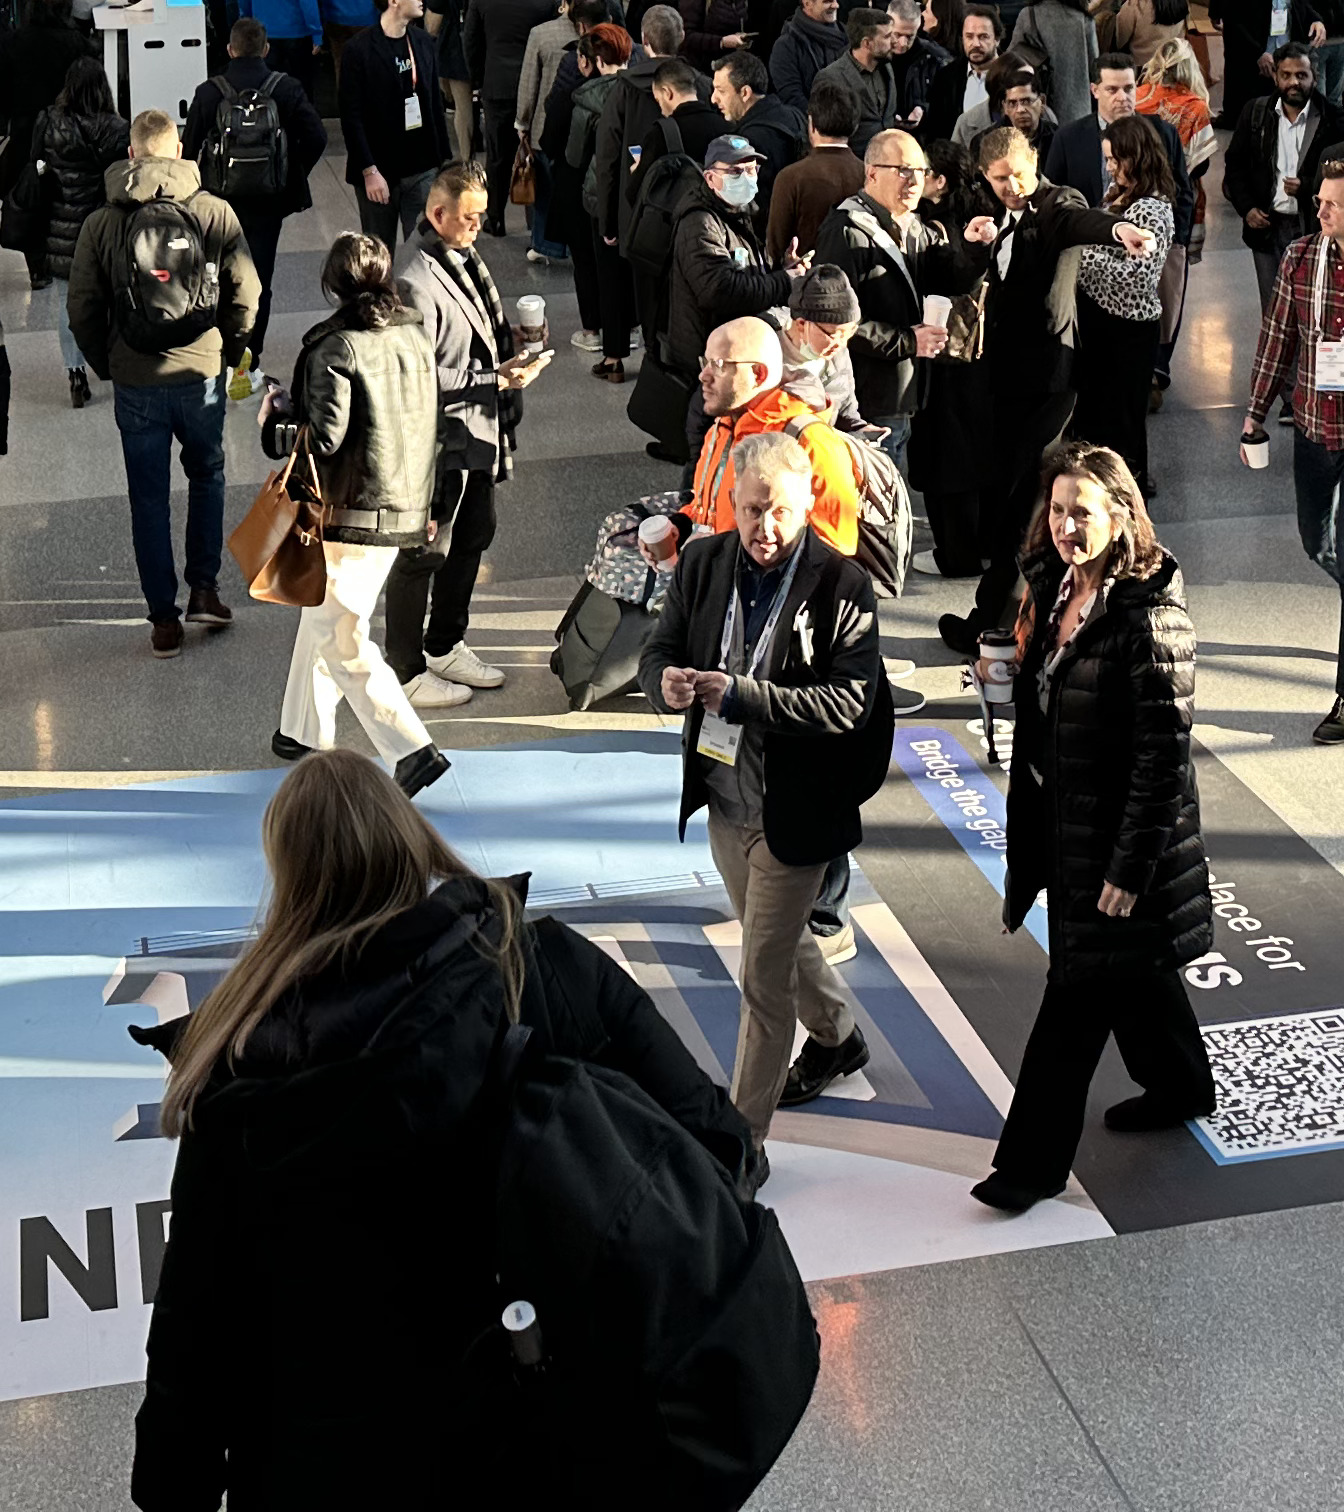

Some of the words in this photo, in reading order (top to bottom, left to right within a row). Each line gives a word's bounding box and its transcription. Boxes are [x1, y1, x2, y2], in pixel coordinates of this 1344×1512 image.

[909, 739, 964, 788] Bridge
[949, 789, 988, 817] the
[965, 818, 1007, 851] gap
[1245, 935, 1306, 972] for
